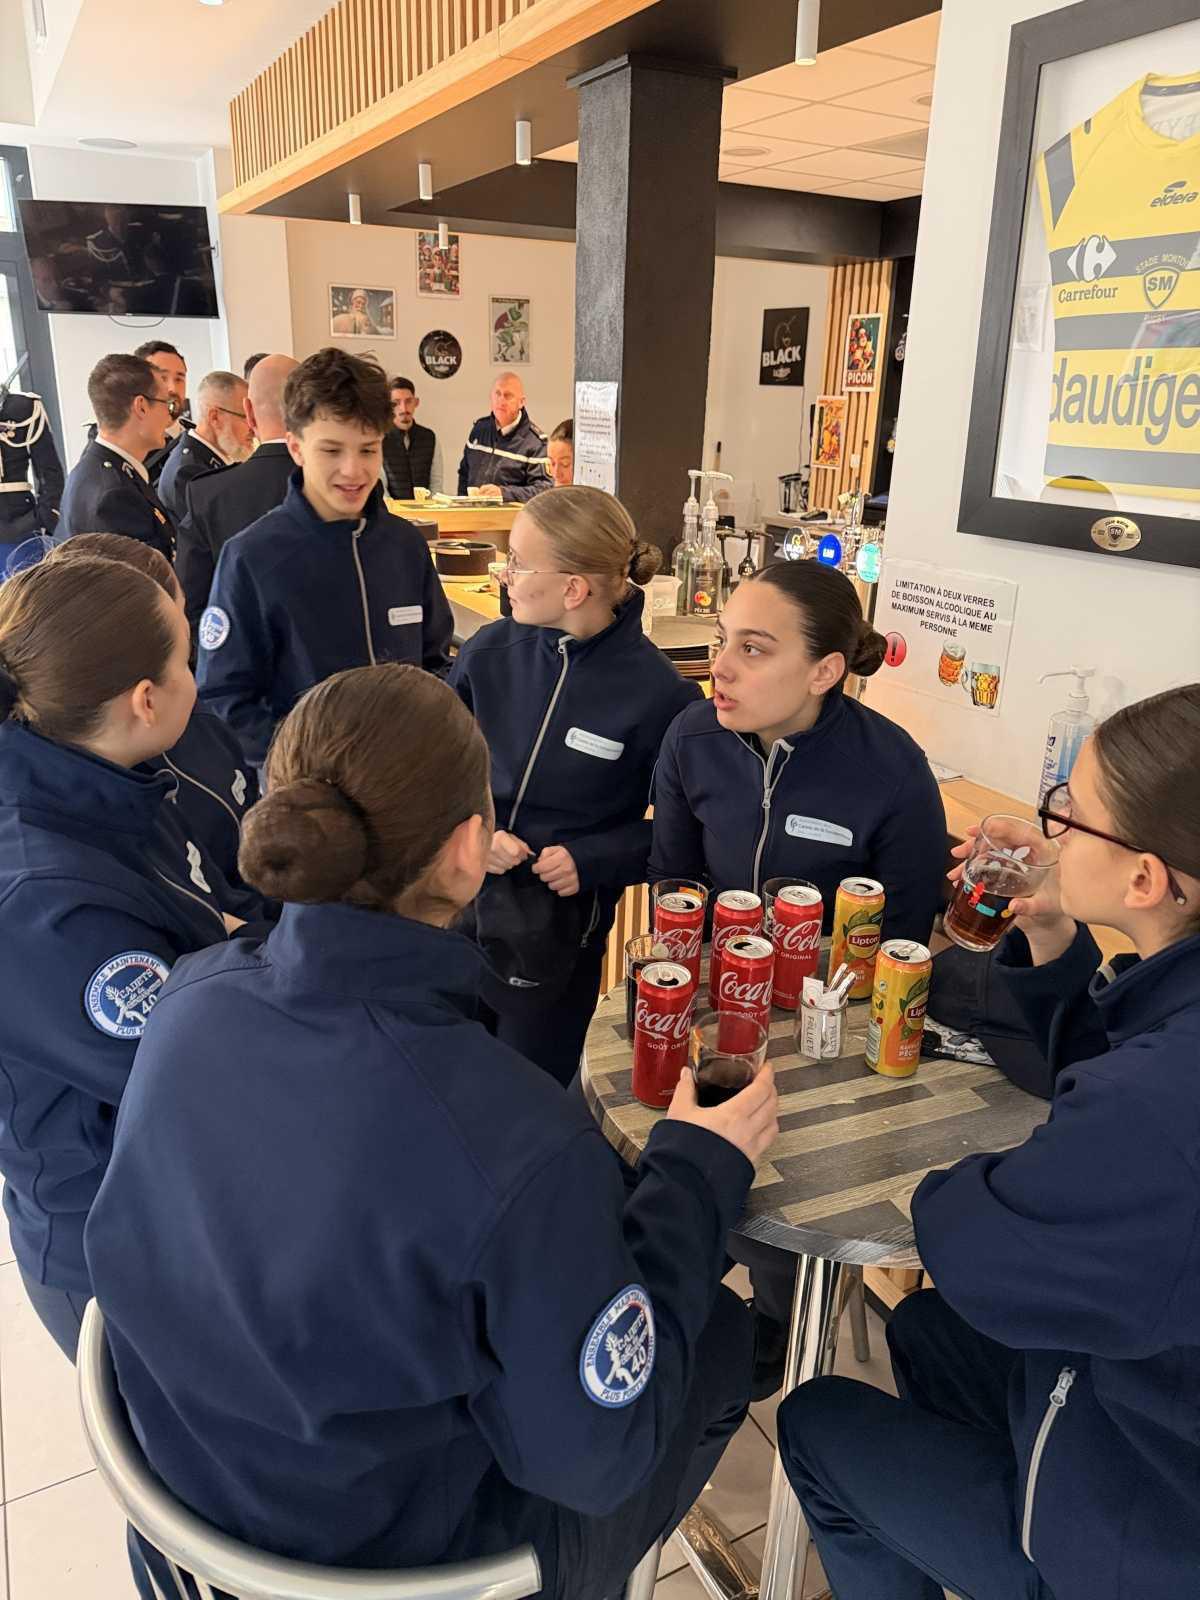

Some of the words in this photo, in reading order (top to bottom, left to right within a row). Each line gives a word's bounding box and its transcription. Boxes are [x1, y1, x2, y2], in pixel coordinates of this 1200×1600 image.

[1150, 192, 1199, 207] eldera
[1147, 276, 1173, 292] SM
[1058, 284, 1119, 304] Carrefour
[426, 355, 457, 365] BLACK
[762, 345, 802, 367] BLACK
[847, 371, 873, 384] PICON
[895, 579, 936, 596] LIMITATION
[943, 589, 962, 601] DEUX
[963, 594, 995, 608] VERRES
[891, 590, 900, 599] DE
[902, 592, 935, 606] BOISSON
[935, 600, 982, 619] ALCOOLIQUE
[983, 611, 997, 621] AU
[891, 602, 925, 617] MAXIMUM
[926, 609, 951, 623] SERVIS
[958, 618, 967, 627] LA
[968, 620, 993, 633] MEME
[920, 620, 958, 637] PERSONNE
[851, 935, 880, 946] Lipton
[781, 951, 812, 960] ORIGINAL
[119, 968, 154, 999] CADETS
[142, 994, 158, 1014] 40
[647, 1041, 668, 1050] GOÛT
[631, 1346, 646, 1373] 40
[600, 1389, 620, 1401] PLUS
